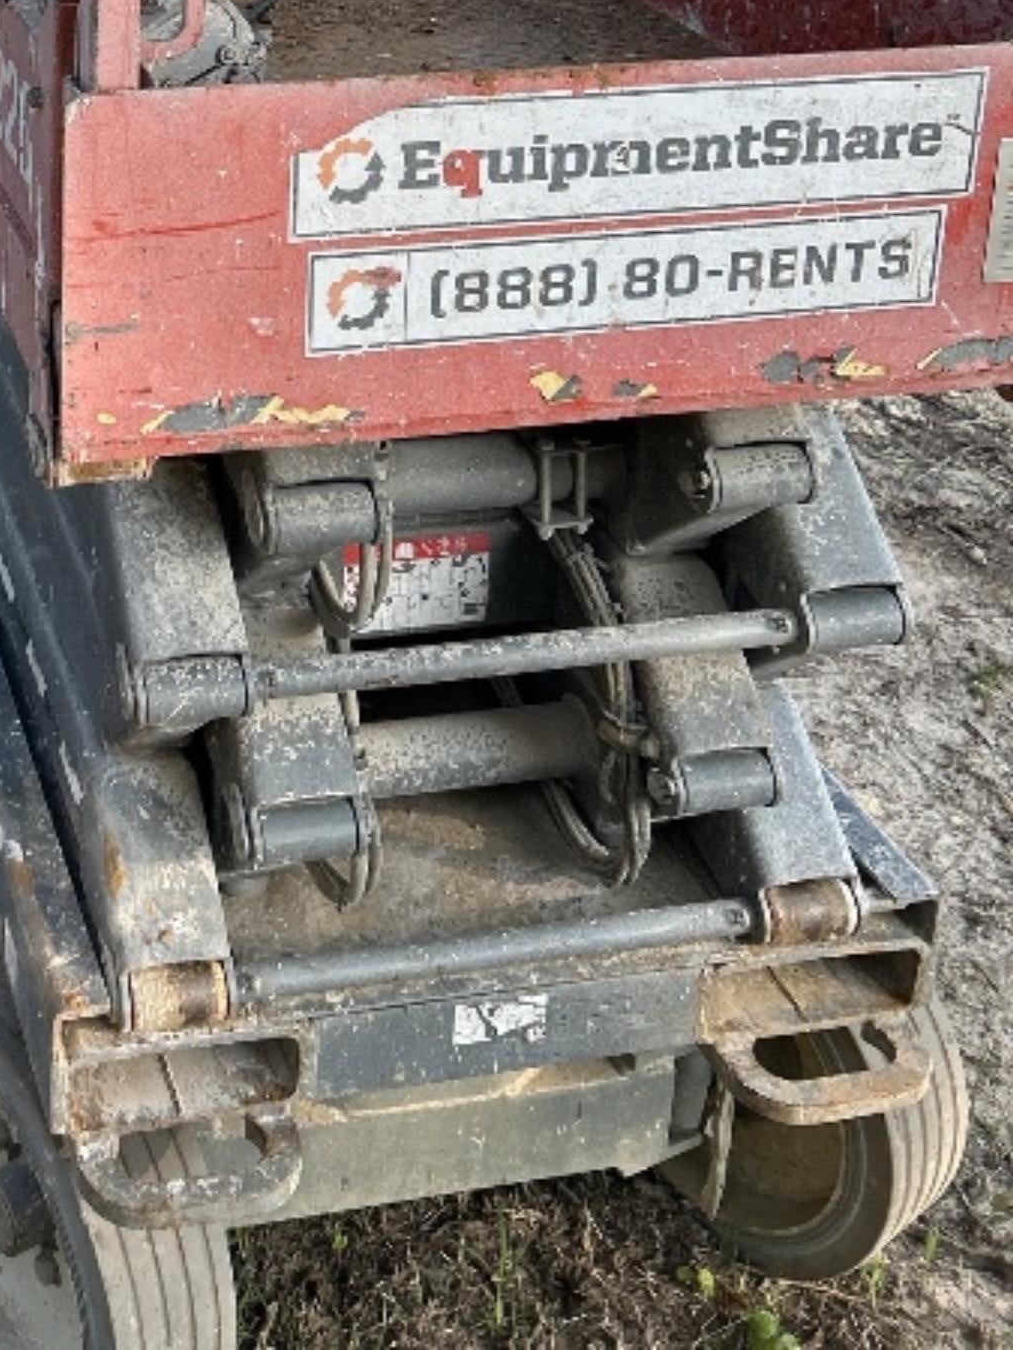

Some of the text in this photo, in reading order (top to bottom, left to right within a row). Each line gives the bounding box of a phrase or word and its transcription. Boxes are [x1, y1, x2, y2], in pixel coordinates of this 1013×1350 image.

[397, 117, 943, 197] EquipmentShare
[431, 239, 911, 319] (888) 80-RENTS
